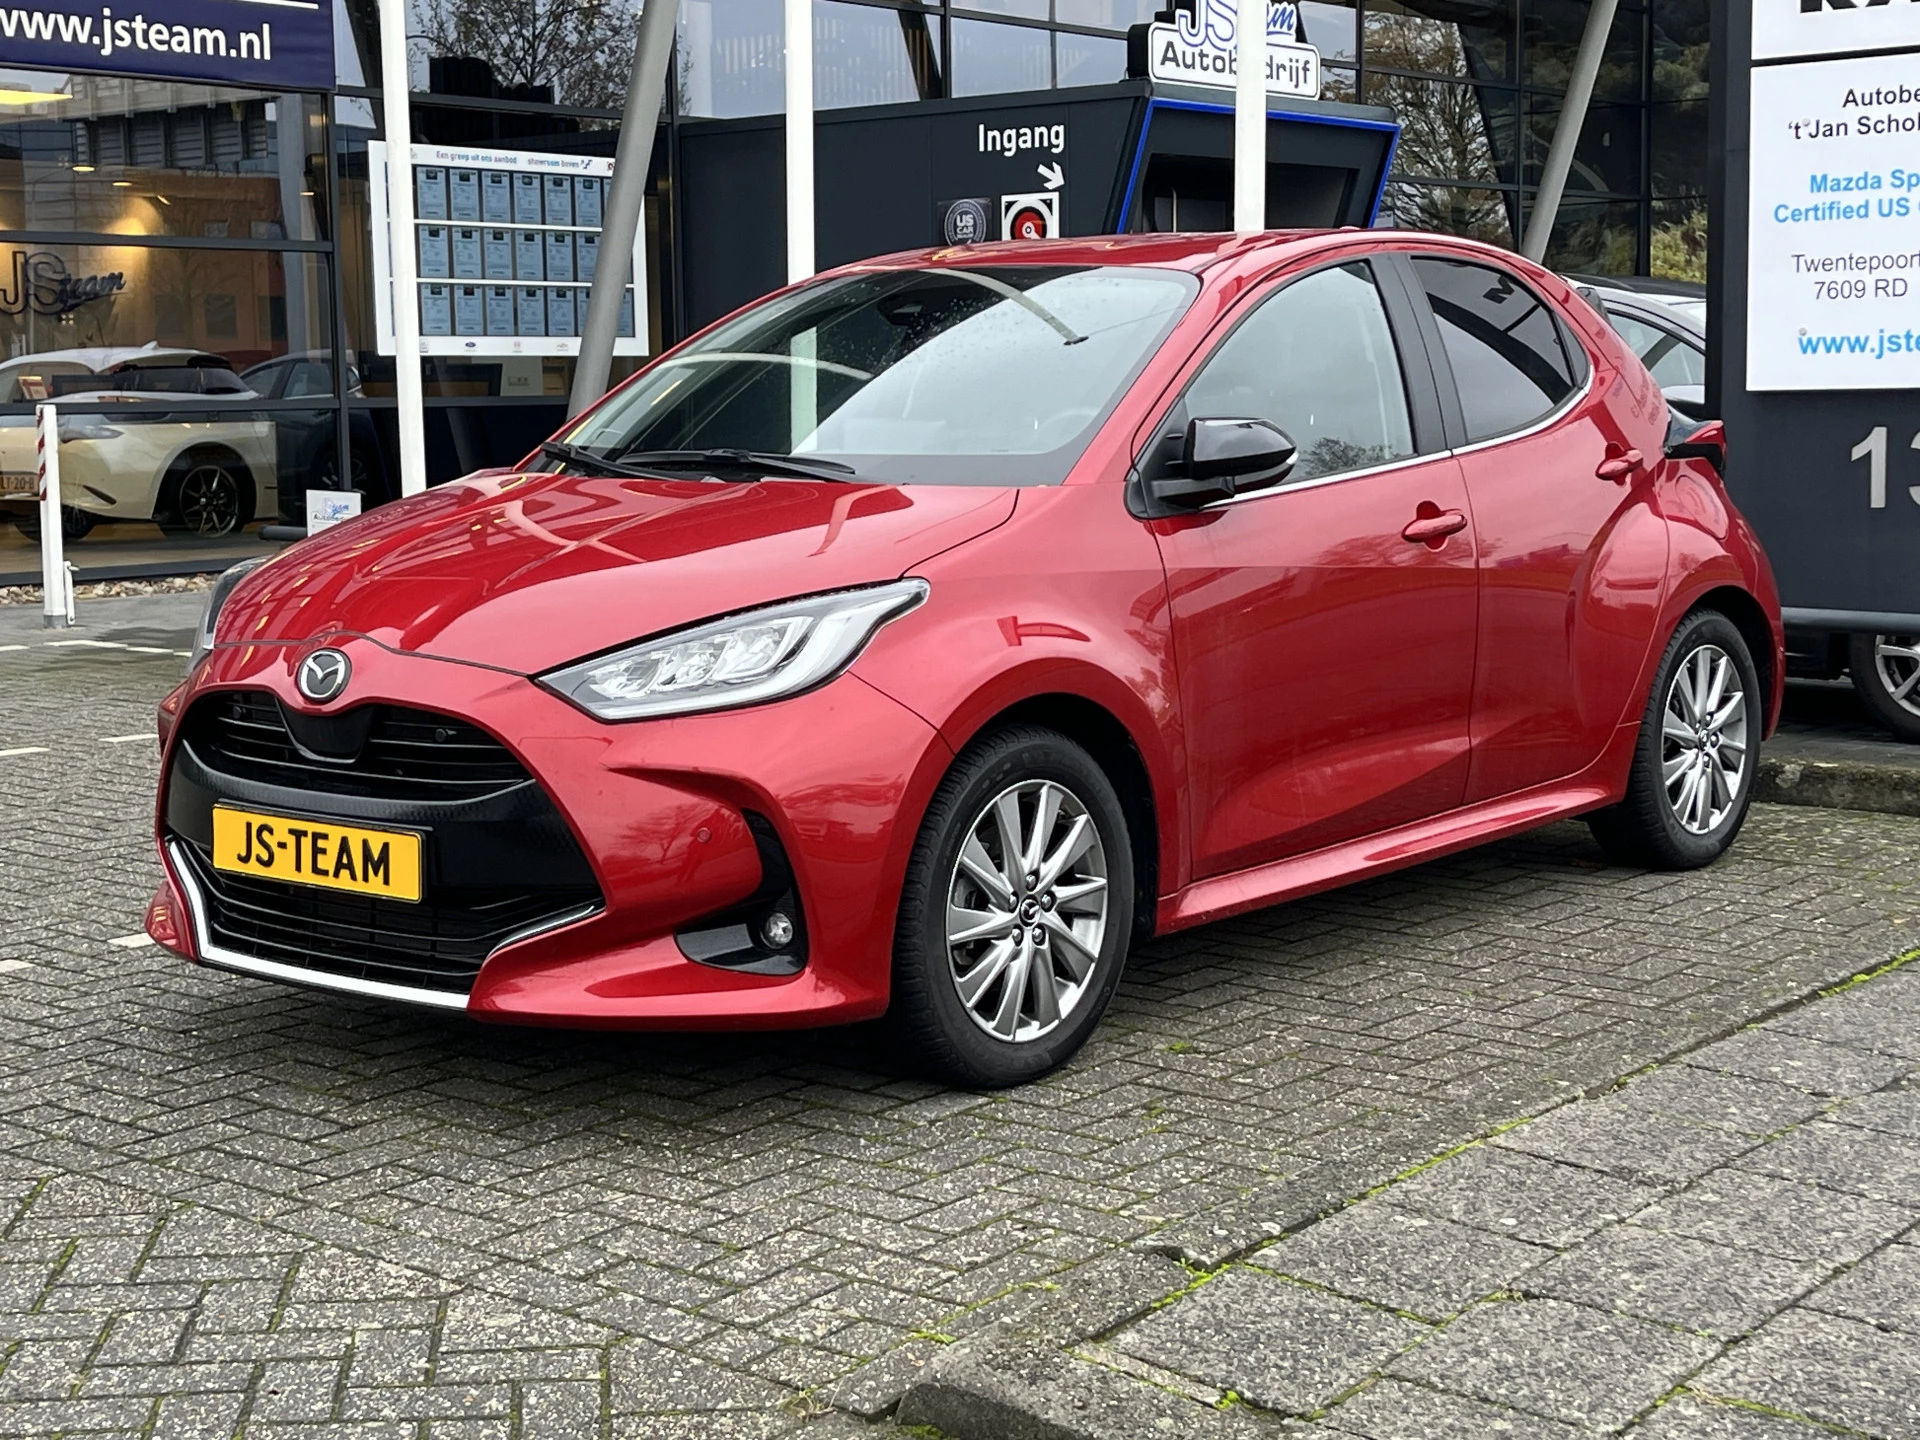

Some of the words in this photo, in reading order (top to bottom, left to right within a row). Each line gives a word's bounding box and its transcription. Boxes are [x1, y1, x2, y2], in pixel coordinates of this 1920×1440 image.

[0, 8, 271, 60] www.jsteam.nl
[1160, 41, 1311, 89] Autobdrijf
[979, 123, 1065, 157] Ingang
[1808, 119, 1848, 139] Jan
[1810, 171, 1882, 193] Mazda
[1890, 168, 1920, 193] Sp
[956, 214, 974, 227] US
[1774, 200, 1870, 223] Certified
[1878, 197, 1911, 218] US
[956, 226, 974, 234] CAR
[1813, 279, 1867, 300] 7609
[1874, 277, 1908, 298] RD
[237, 821, 390, 886] JS-TEAM
